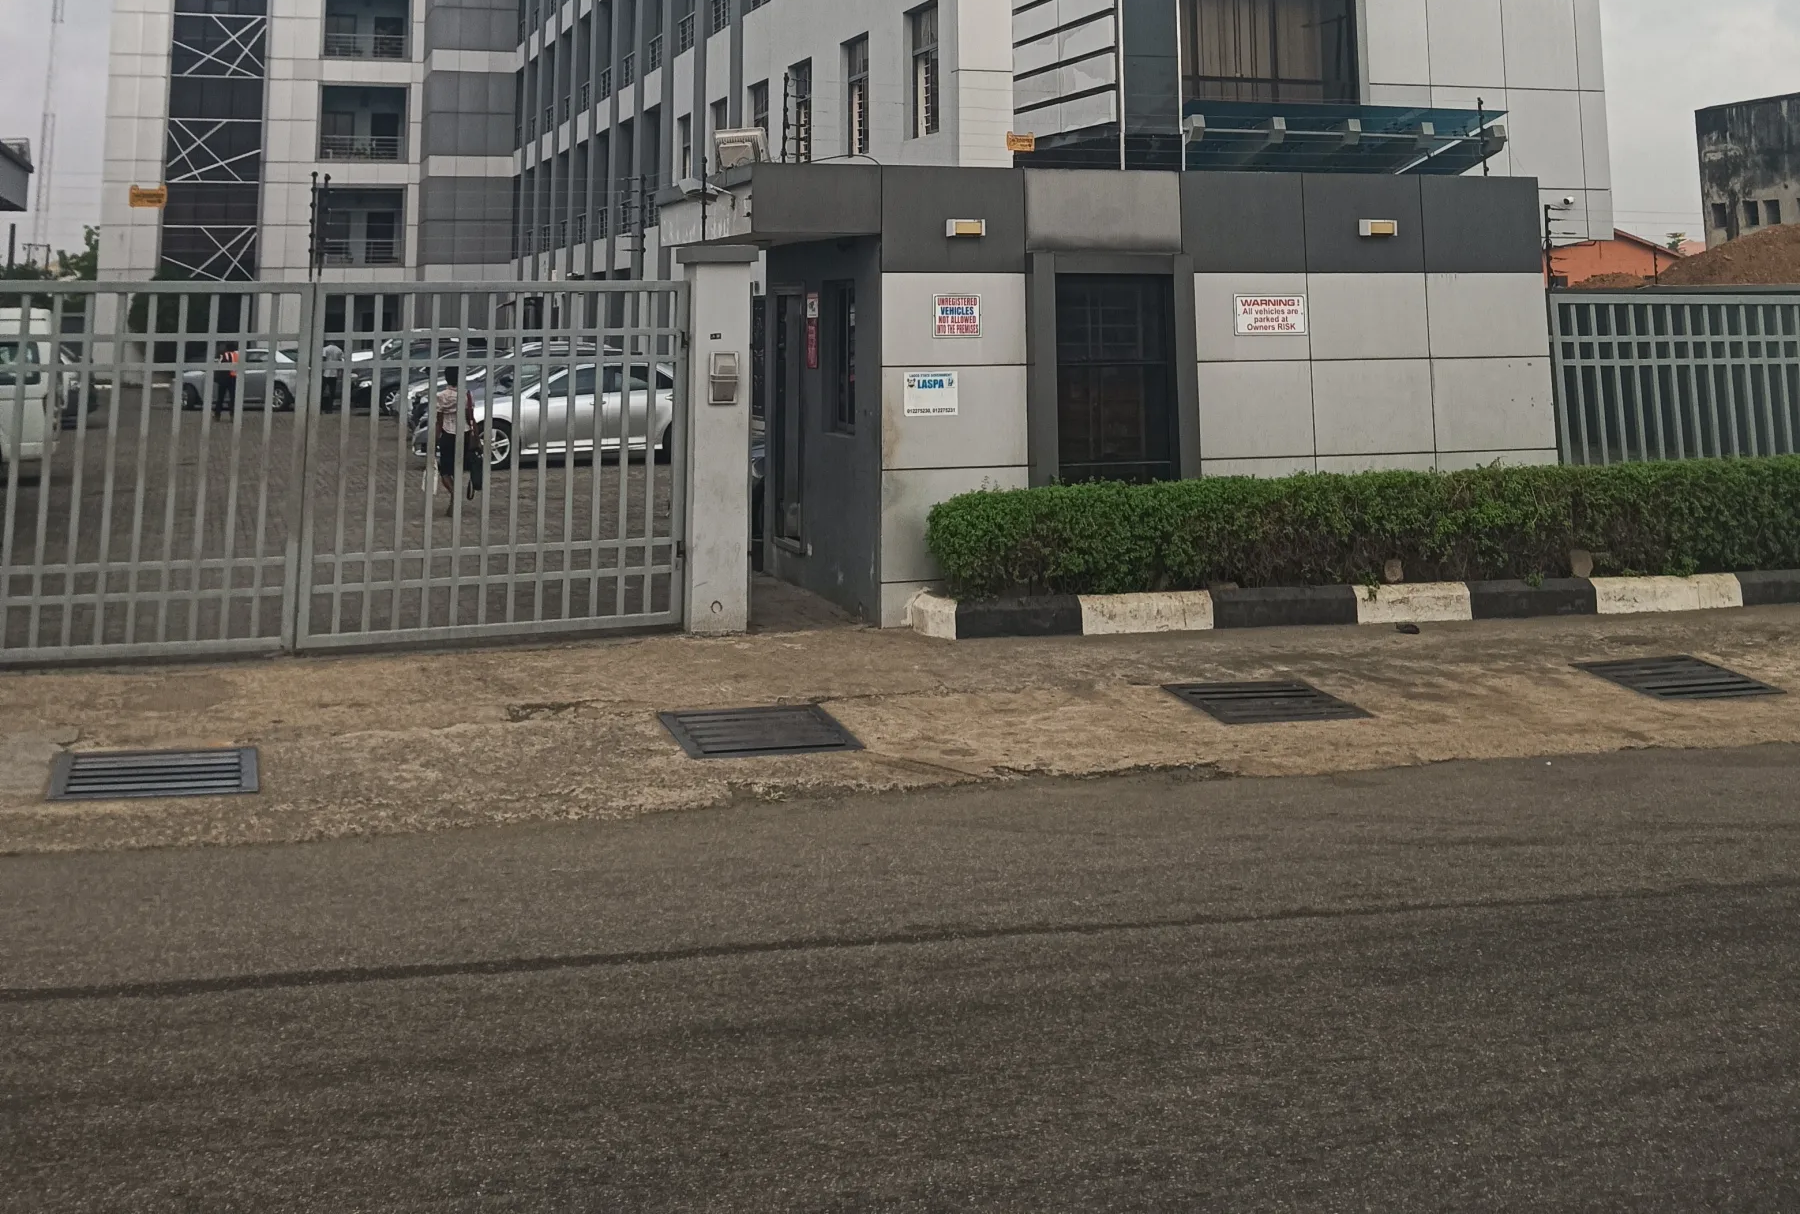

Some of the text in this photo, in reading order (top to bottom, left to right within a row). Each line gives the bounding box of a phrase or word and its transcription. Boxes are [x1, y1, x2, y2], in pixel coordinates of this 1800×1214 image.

[937, 297, 977, 306] UNREGISTERED
[940, 307, 974, 315] VEHICLES
[1254, 316, 1279, 324] parked
[957, 324, 978, 333] PREMISES
[917, 379, 944, 389] LASPA
